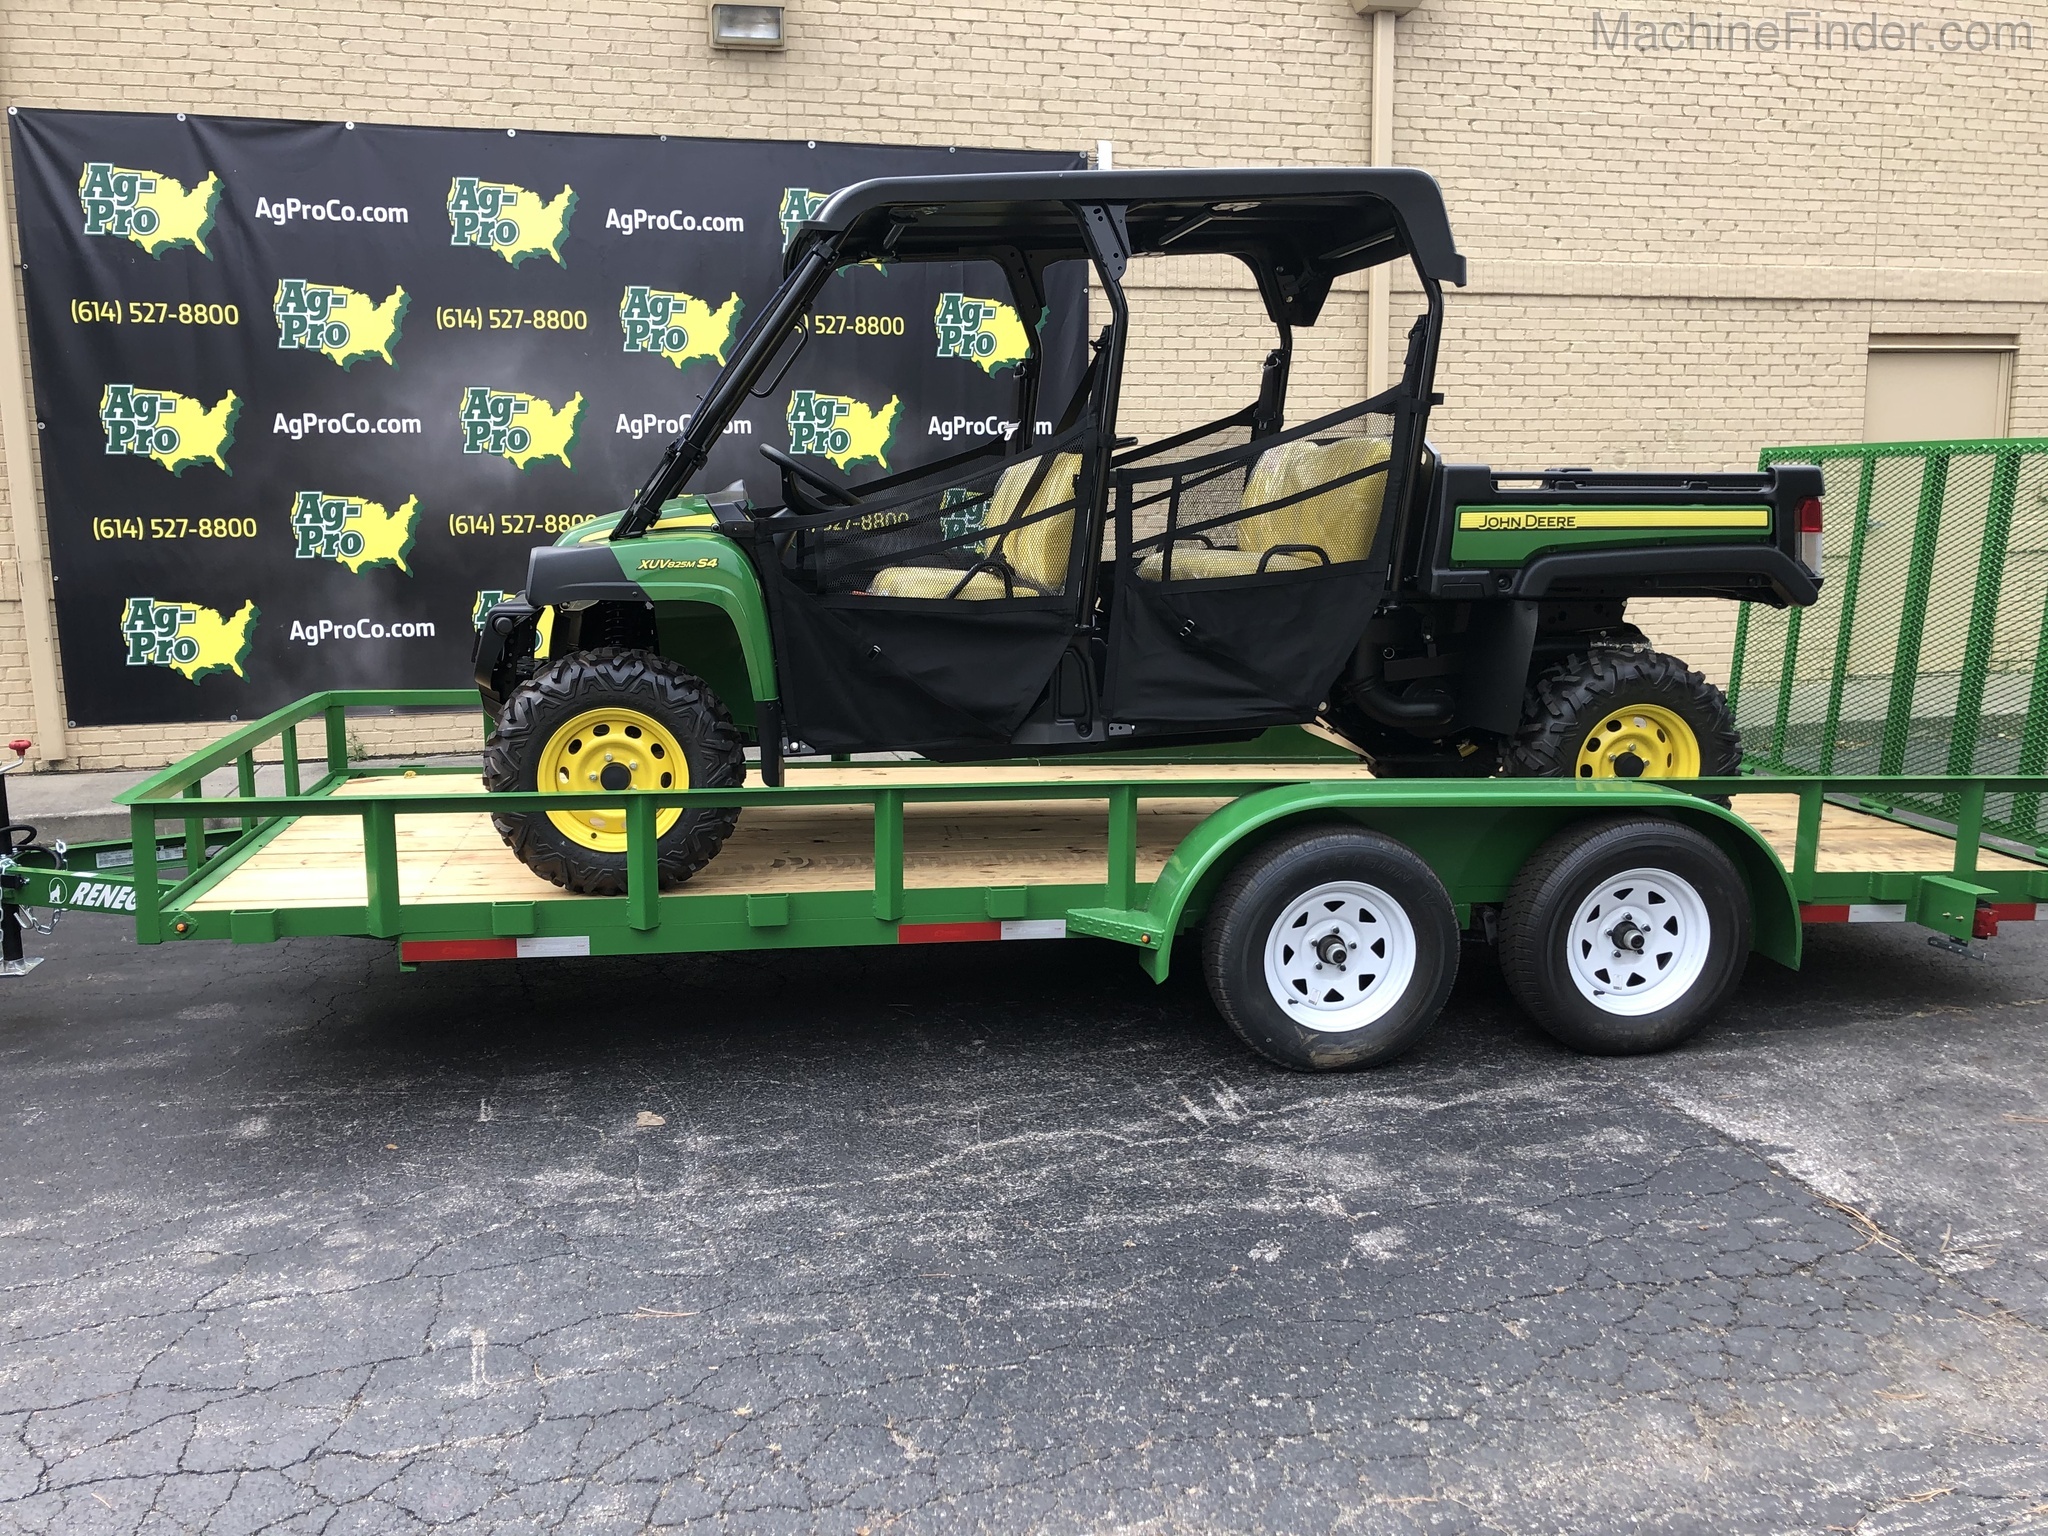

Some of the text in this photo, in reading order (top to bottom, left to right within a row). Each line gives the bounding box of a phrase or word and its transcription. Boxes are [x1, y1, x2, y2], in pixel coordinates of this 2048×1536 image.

[82, 162, 157, 203] Ag-
[450, 177, 516, 217] Ag-
[84, 198, 158, 235] Pro
[254, 196, 409, 226] AgProCo.com
[605, 207, 744, 236] AgProCo.com
[451, 212, 519, 245] Pro
[71, 298, 239, 326] (614) 527-8800
[276, 279, 347, 319] Ag-
[623, 286, 686, 321] Ag-
[938, 292, 996, 329] Ag-
[279, 314, 349, 349] Pro
[436, 306, 588, 331] (614) 527-8800
[624, 318, 688, 352] Pro
[814, 315, 905, 336] 527-8800
[937, 324, 996, 357] Pro
[102, 384, 176, 421] Ag-
[462, 387, 528, 425] Ag-
[789, 390, 849, 426] Ag-
[105, 418, 180, 454] Pro
[272, 412, 422, 440] AgProCo.com
[464, 420, 530, 453] Pro
[615, 413, 752, 440] AgProCom
[790, 421, 851, 454] Pro
[927, 415, 1052, 441] AgProCom
[294, 492, 361, 530] Ag-
[449, 513, 495, 537] (614)
[1478, 514, 1577, 529] JOHN DEERE
[93, 516, 257, 541] (614) 527-8800
[296, 525, 363, 558] Pro
[697, 557, 718, 569] S4
[123, 598, 195, 636] Ag-
[289, 618, 436, 646] AgProCo.com
[127, 631, 199, 665] Pro
[69, 881, 137, 911] RENEG
